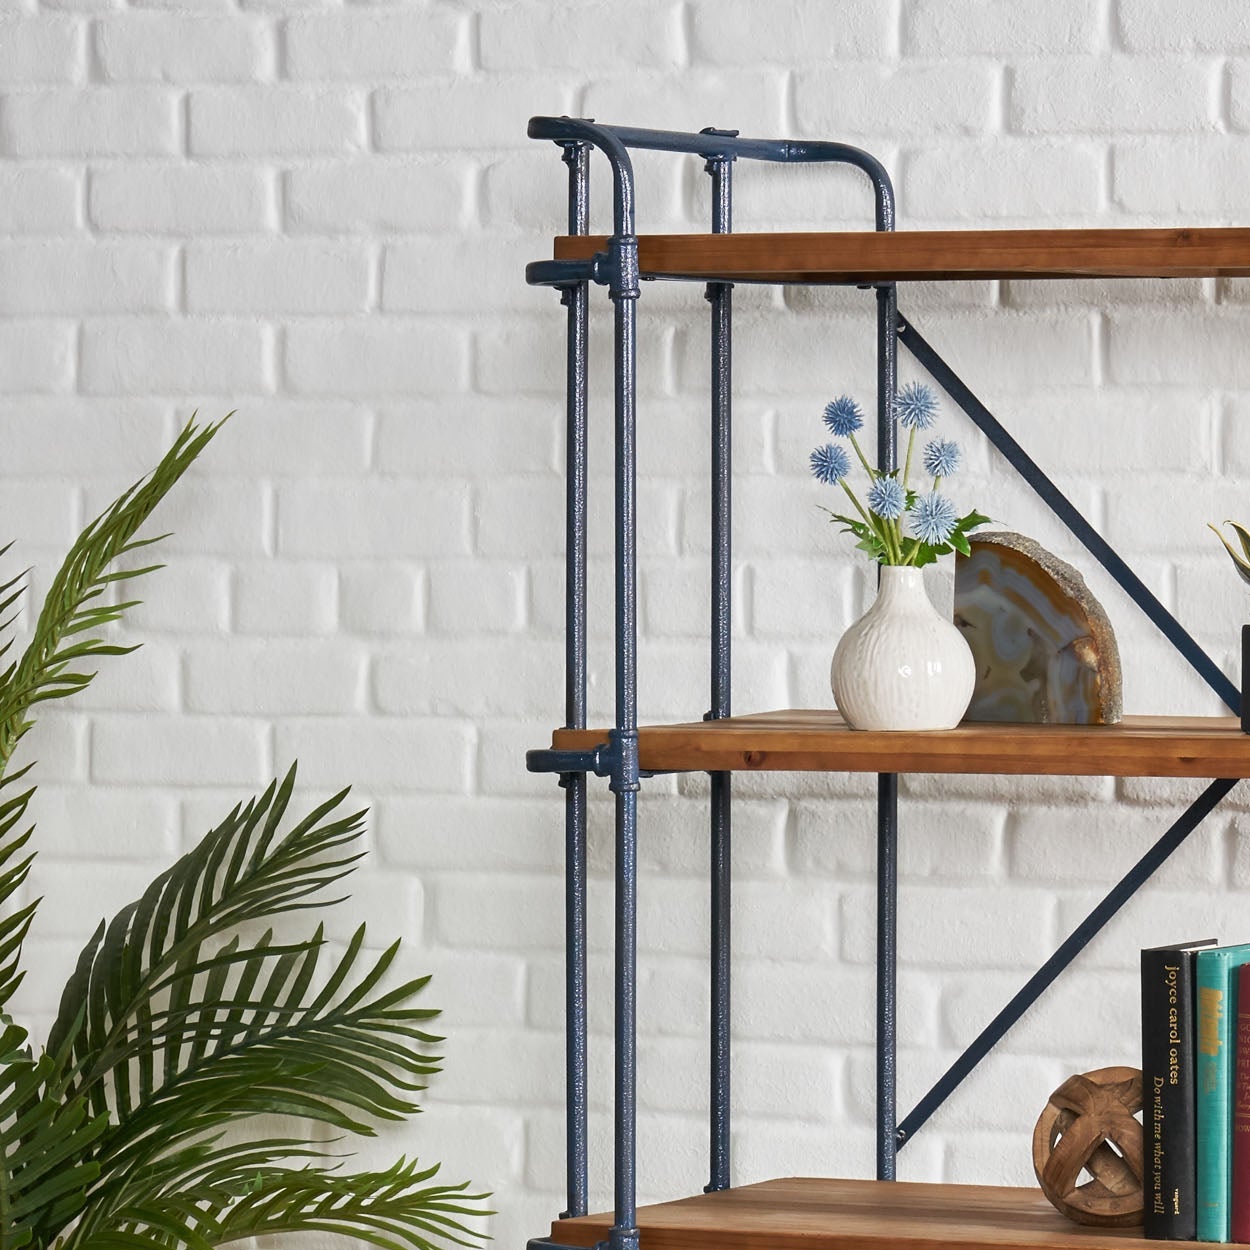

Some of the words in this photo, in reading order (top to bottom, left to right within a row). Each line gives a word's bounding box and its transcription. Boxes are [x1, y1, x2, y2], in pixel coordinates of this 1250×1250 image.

[1164, 964, 1180, 1004] joyce
[1169, 1007, 1181, 1044] carol
[1169, 1048, 1180, 1085] oates
[1153, 1076, 1165, 1094] Do
[1153, 1095, 1165, 1122] with
[1153, 1123, 1162, 1140] me
[1153, 1142, 1165, 1170] what
[1151, 1171, 1162, 1190] you
[1153, 1192, 1165, 1214] will
